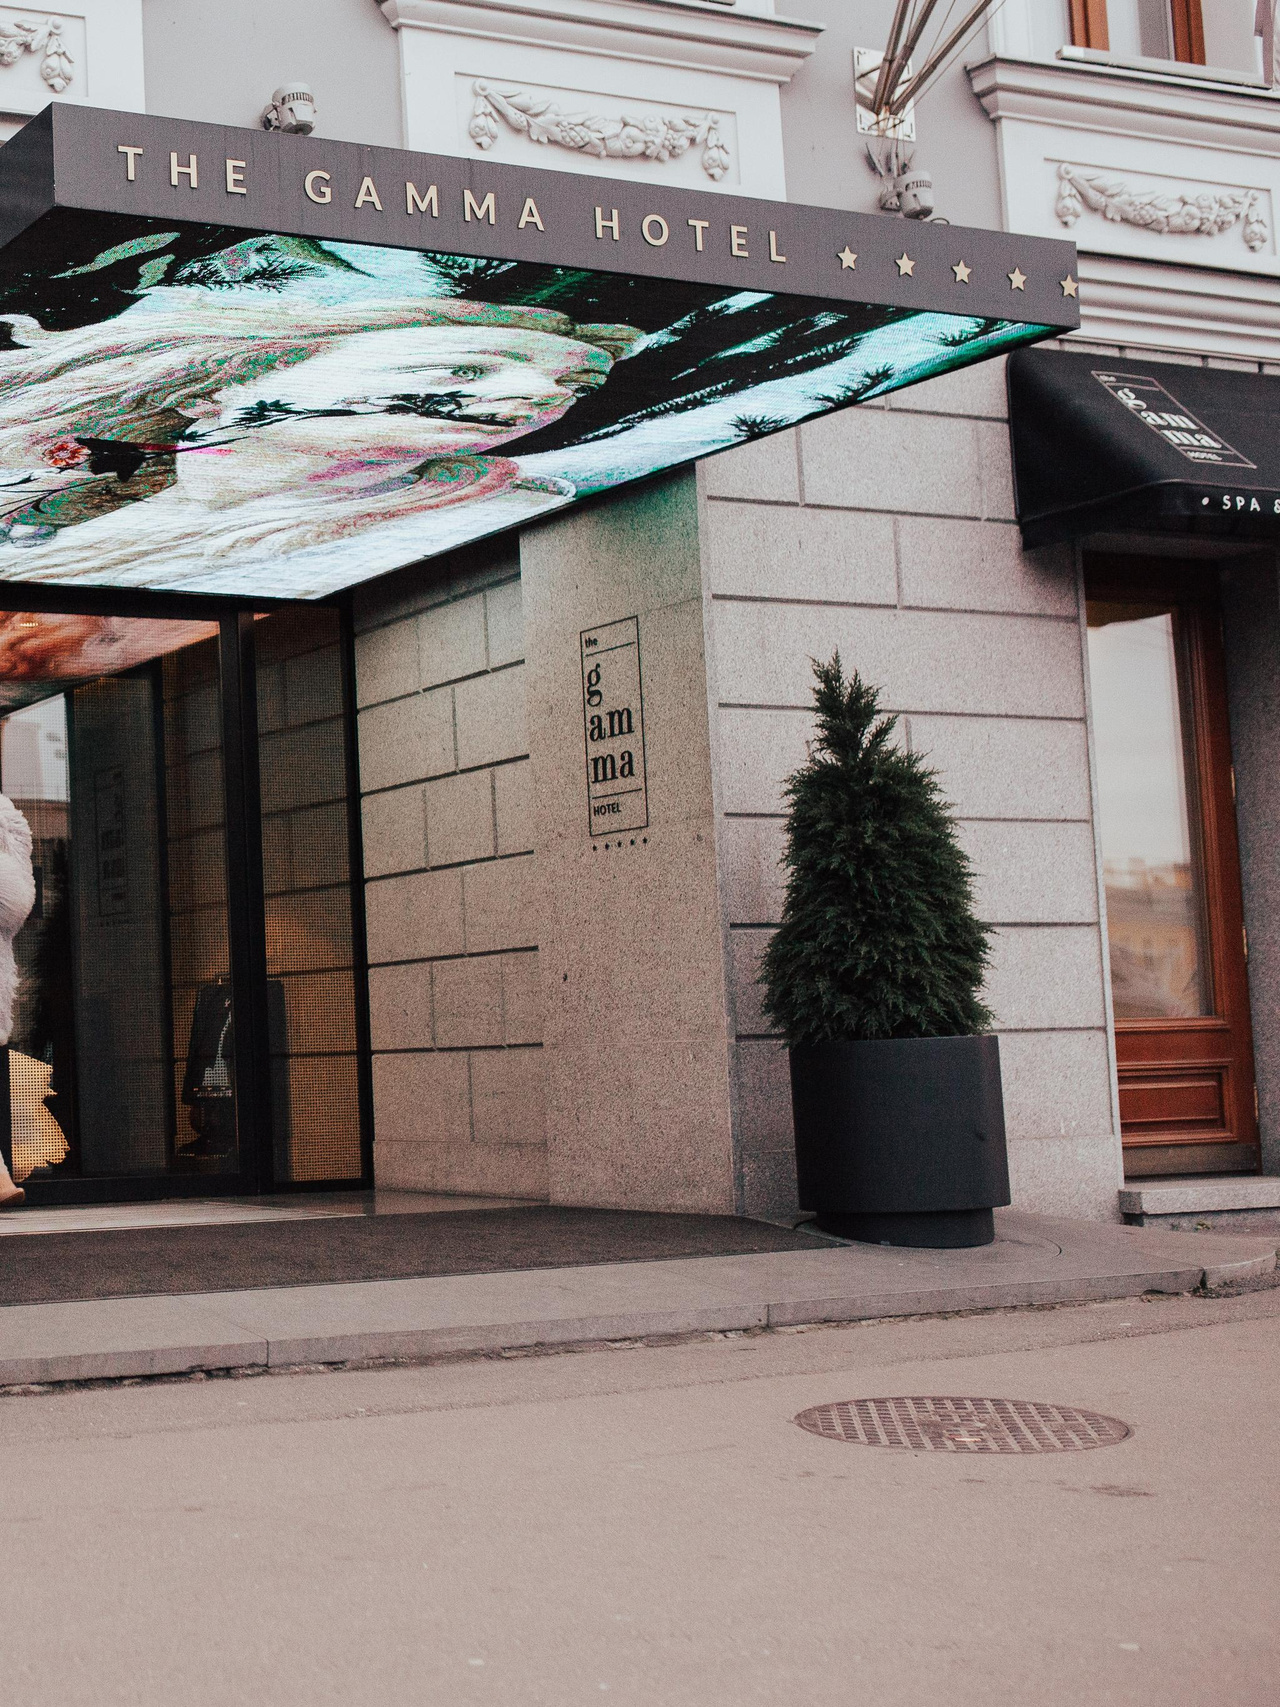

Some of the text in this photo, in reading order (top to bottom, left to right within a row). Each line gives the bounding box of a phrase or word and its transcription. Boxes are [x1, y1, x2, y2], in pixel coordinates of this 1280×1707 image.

[117, 145, 787, 263] THE GAMMA HOTEL
[1222, 494, 1261, 512] SPA
[585, 637, 598, 649] the
[593, 802, 622, 817] HOTEL
